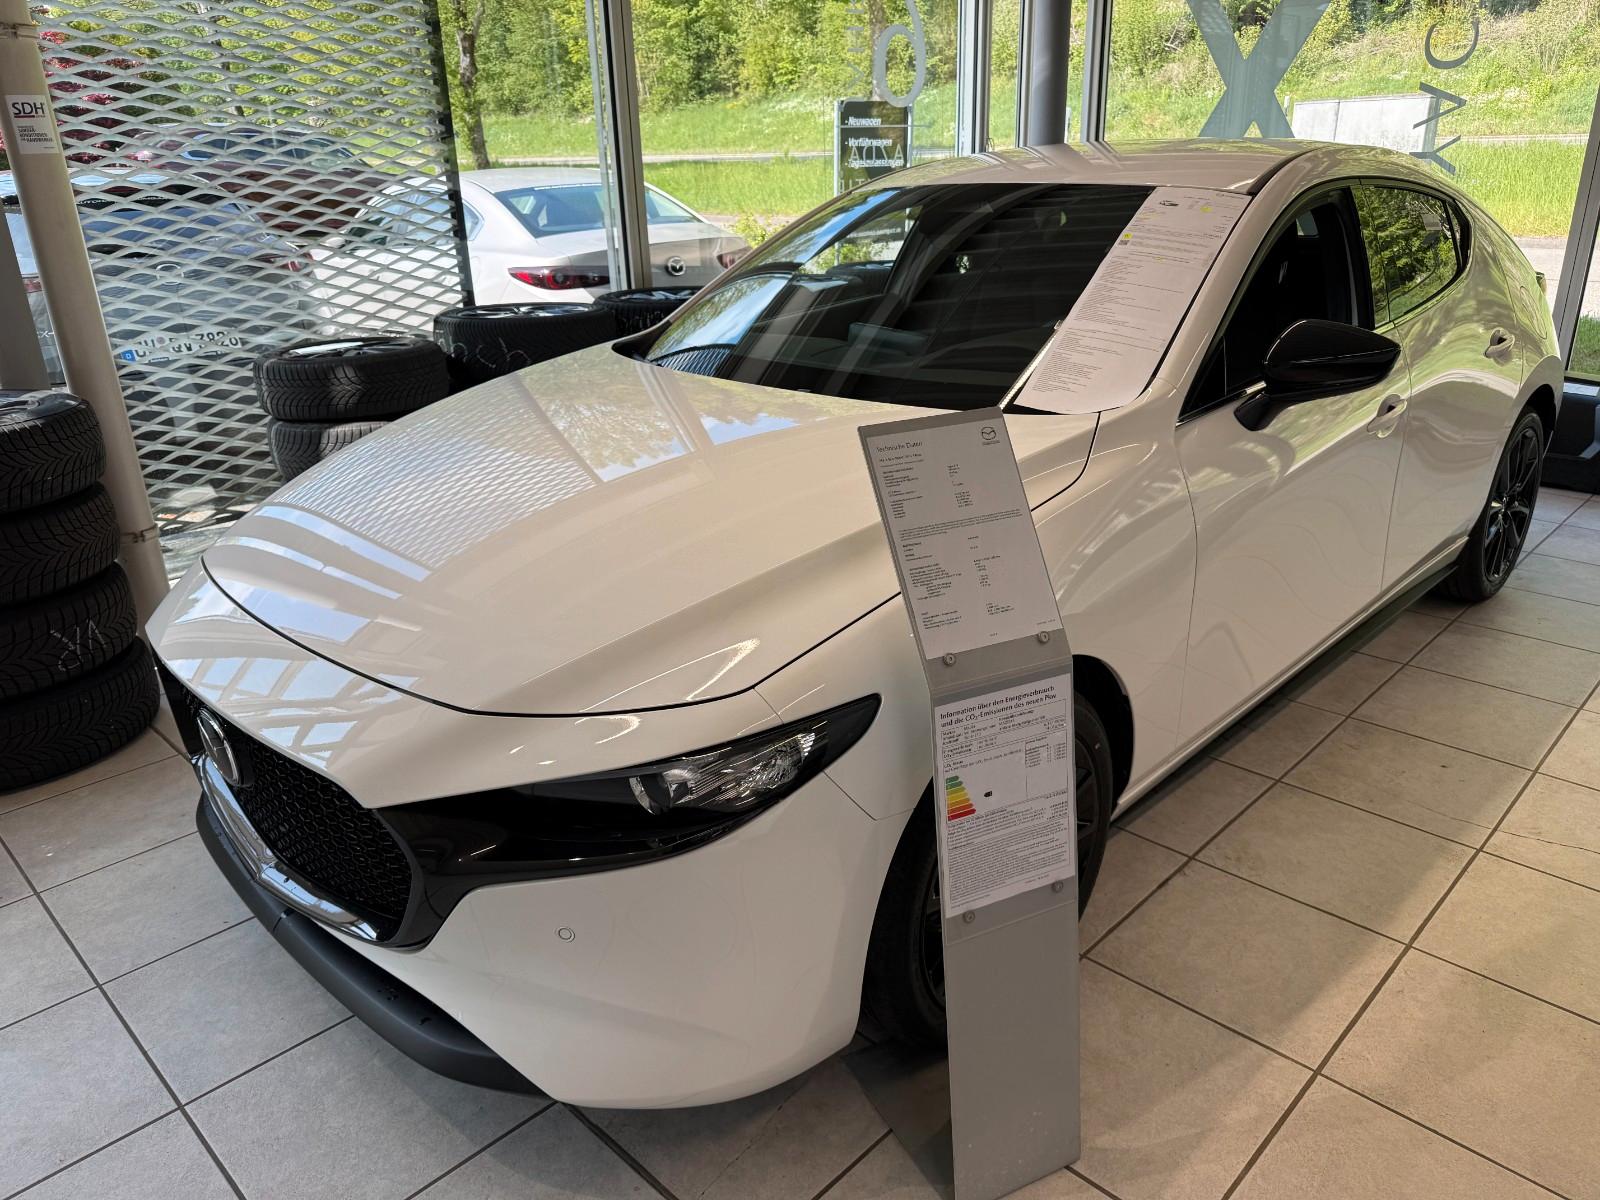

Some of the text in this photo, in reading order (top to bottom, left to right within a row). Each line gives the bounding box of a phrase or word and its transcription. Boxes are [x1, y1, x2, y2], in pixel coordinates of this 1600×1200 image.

[12, 102, 45, 115] SDH
[847, 116, 882, 127] Neuwagen
[848, 137, 893, 148] Vorführwagen
[940, 686, 1055, 720] Information über den Energieverbrauch
[940, 720, 953, 728] und
[954, 717, 965, 725] die
[1013, 702, 1025, 710] des
[1025, 698, 1044, 706] neuen
[1044, 694, 1057, 702] Pkw
